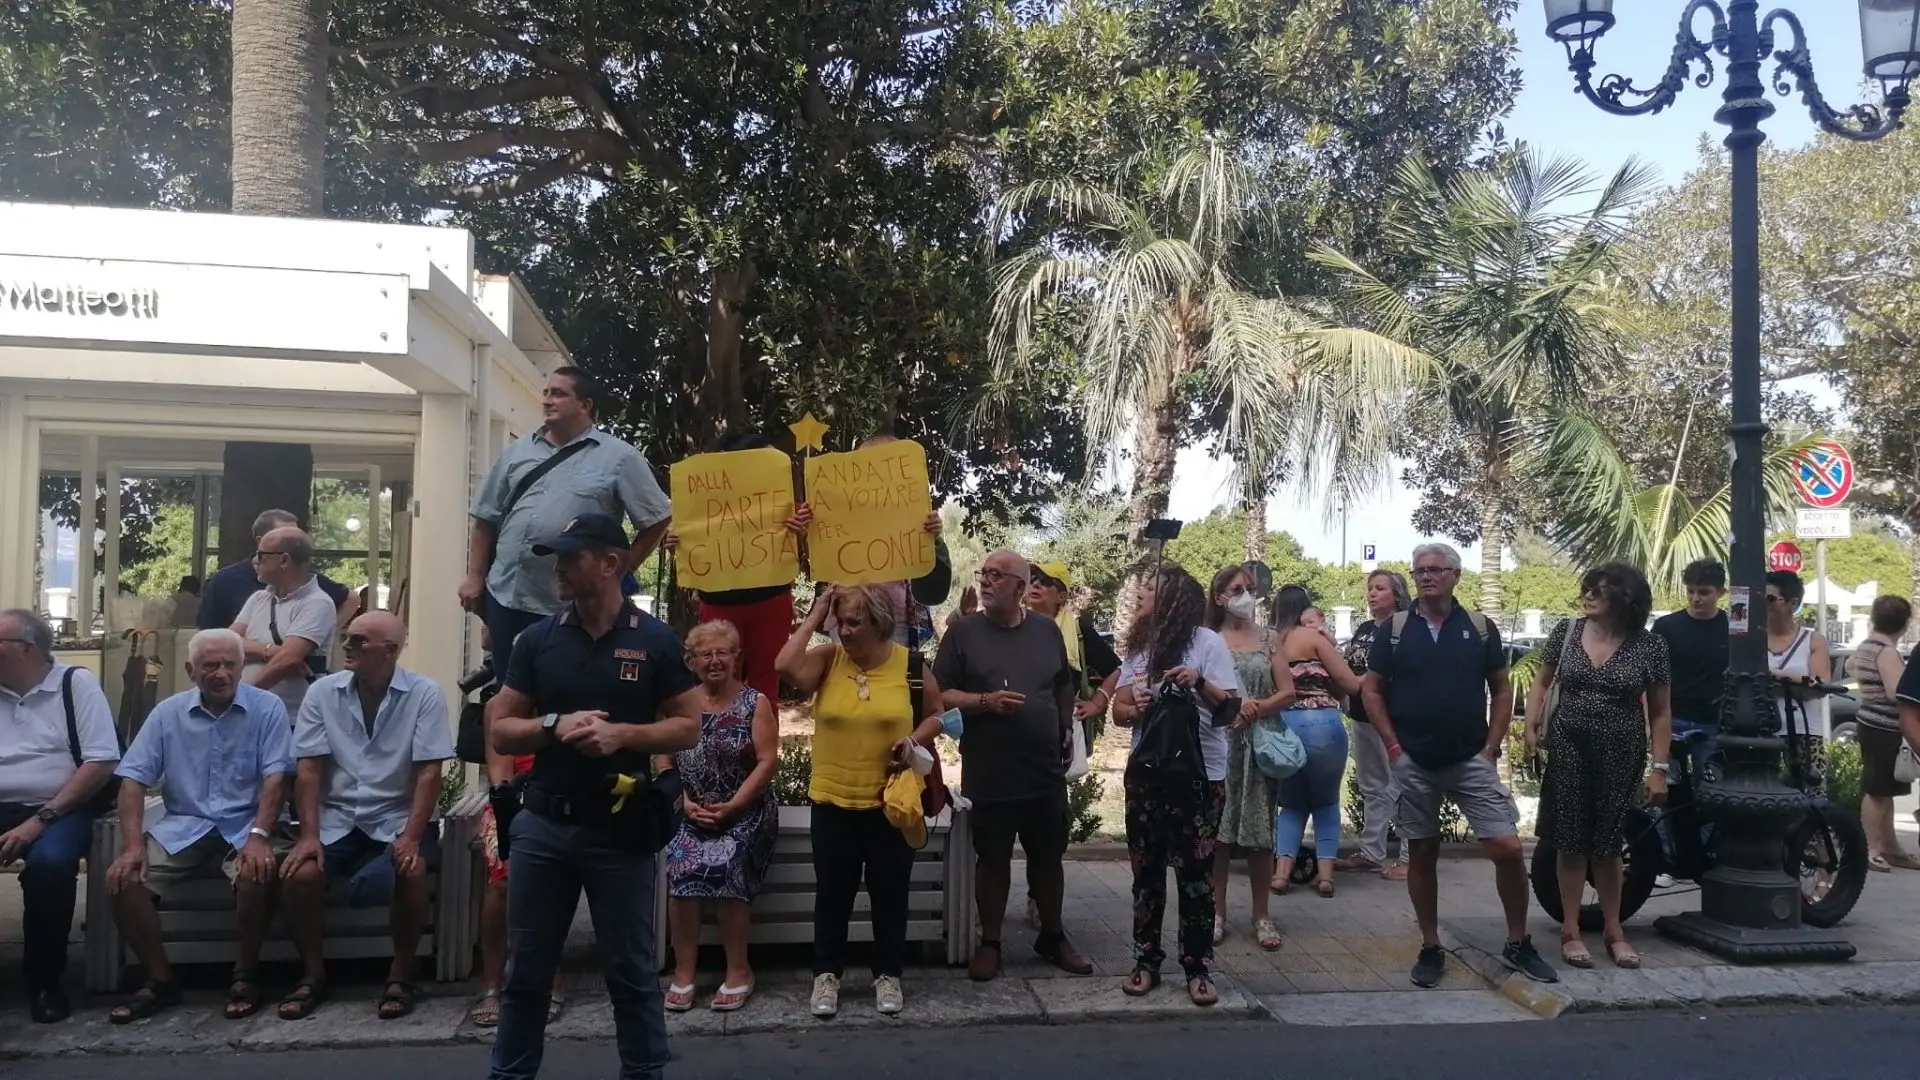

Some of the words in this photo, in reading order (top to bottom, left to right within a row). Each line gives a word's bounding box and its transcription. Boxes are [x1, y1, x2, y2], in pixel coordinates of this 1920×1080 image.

[8, 279, 159, 318] Matteotti
[687, 469, 733, 494] DALLA
[813, 456, 913, 487] ANDATE
[813, 489, 832, 512] A
[843, 482, 921, 512] VOTARE
[705, 490, 787, 536] PARTE
[816, 520, 849, 542] PER
[688, 531, 799, 576] GIUSTA
[838, 530, 932, 574] CONTE
[1770, 552, 1801, 566] STOP
